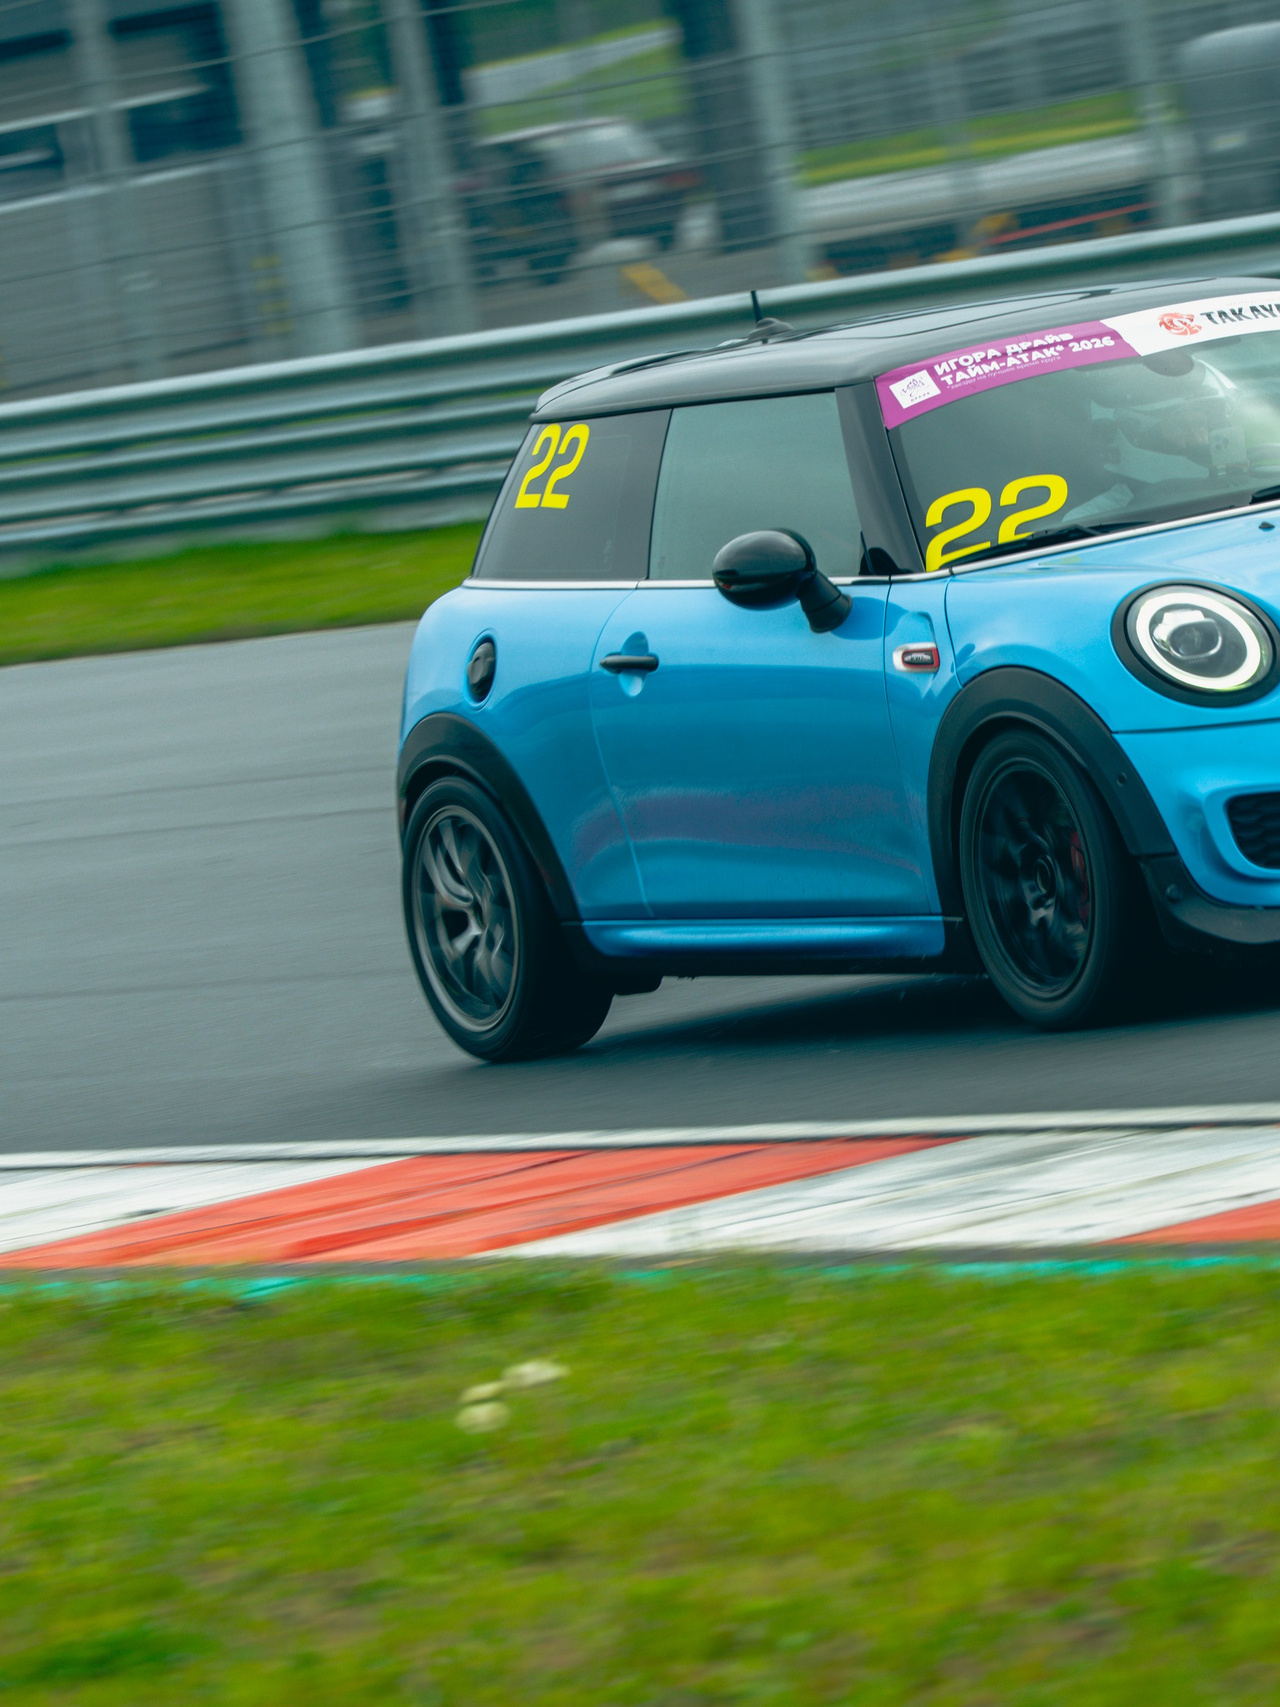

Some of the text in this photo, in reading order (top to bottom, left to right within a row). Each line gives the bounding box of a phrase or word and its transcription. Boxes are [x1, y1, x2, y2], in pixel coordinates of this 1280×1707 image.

[934, 333, 1074, 376] ИГОРА ДРАЙВ
[1068, 336, 1115, 353] 2026
[514, 423, 590, 509] 22
[925, 474, 1068, 573] 22
